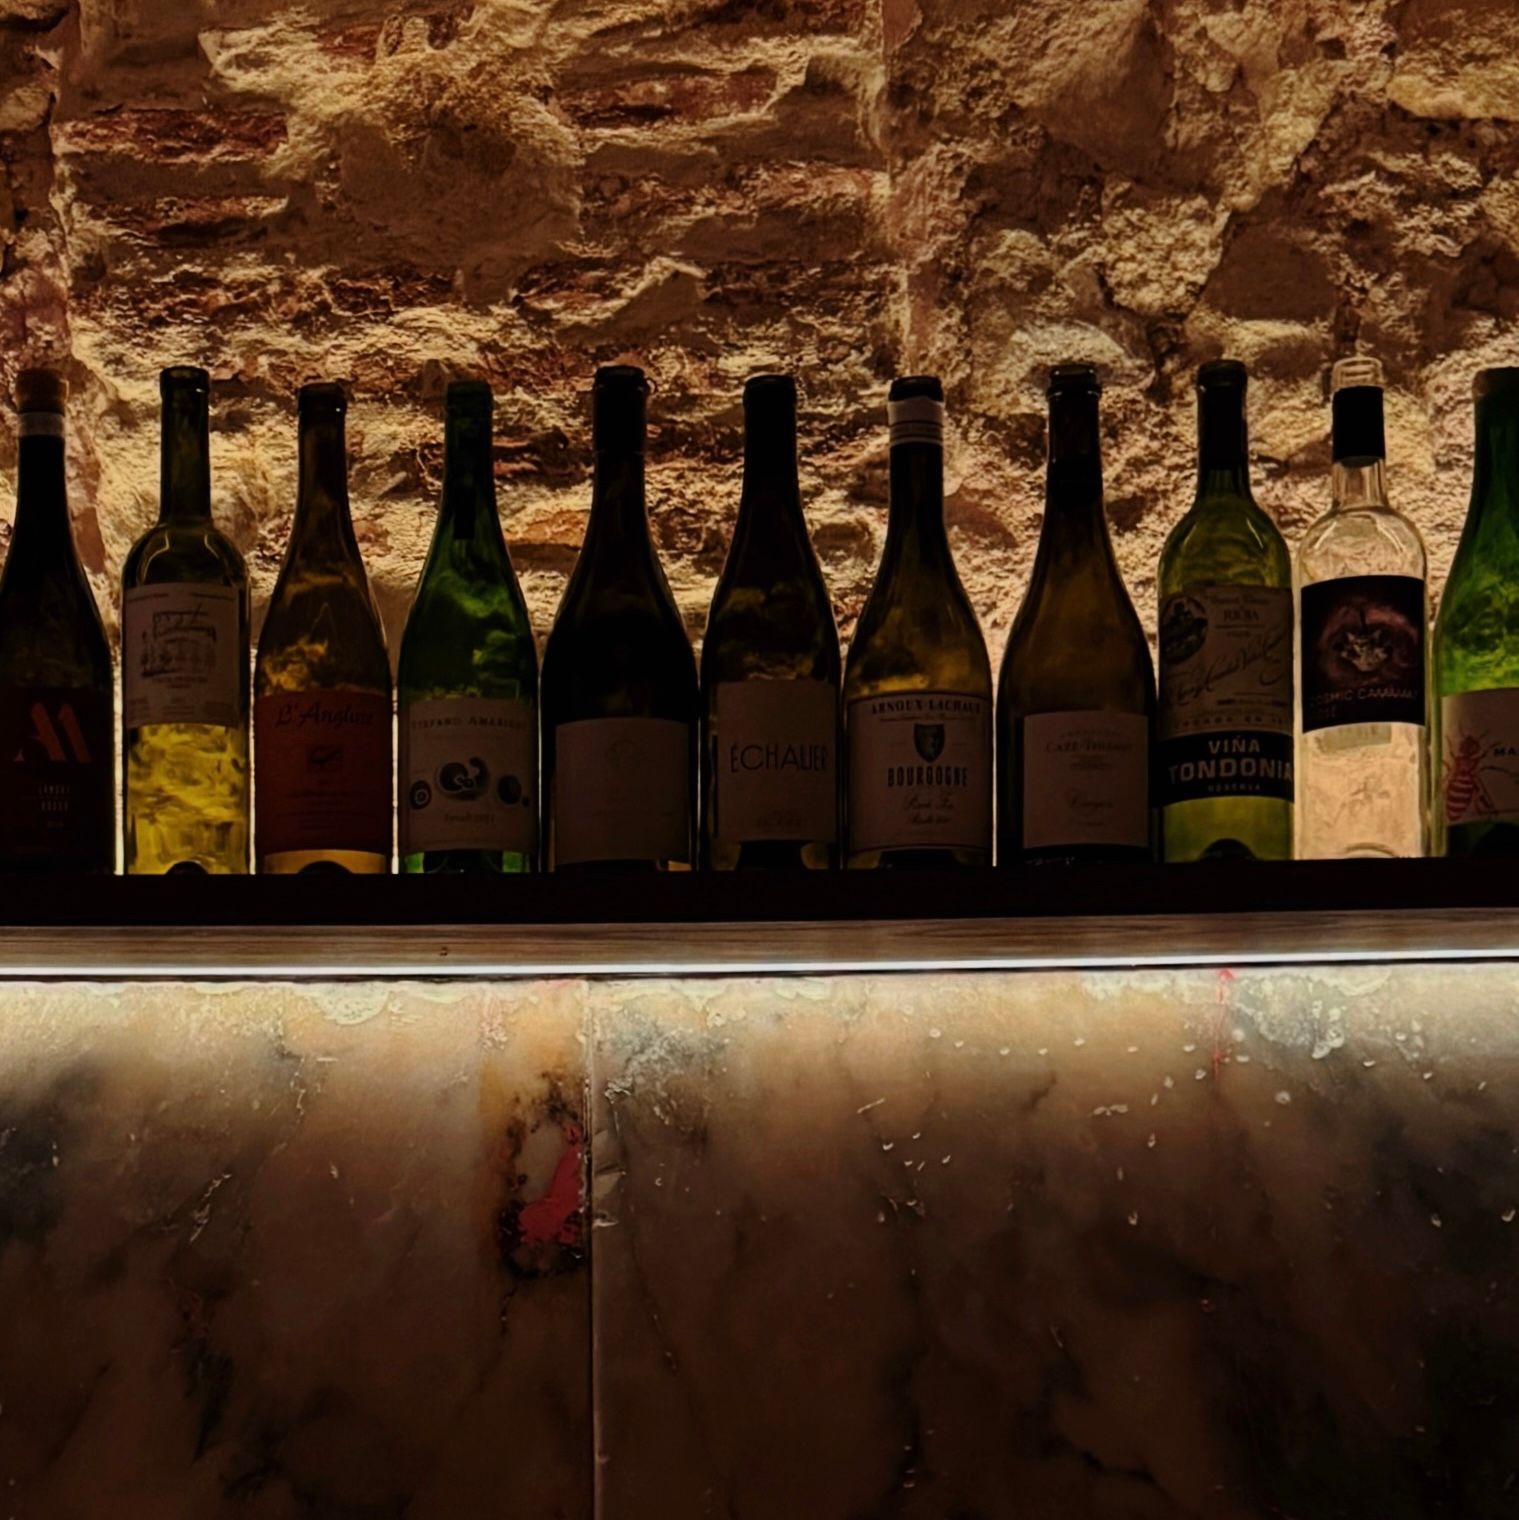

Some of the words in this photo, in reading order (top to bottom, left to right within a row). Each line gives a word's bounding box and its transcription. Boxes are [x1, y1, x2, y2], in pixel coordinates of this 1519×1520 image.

[1208, 735, 1261, 754] VIÑA
[887, 765, 968, 788] BOURGOGNE
[1167, 757, 1293, 785] TONDONIA
